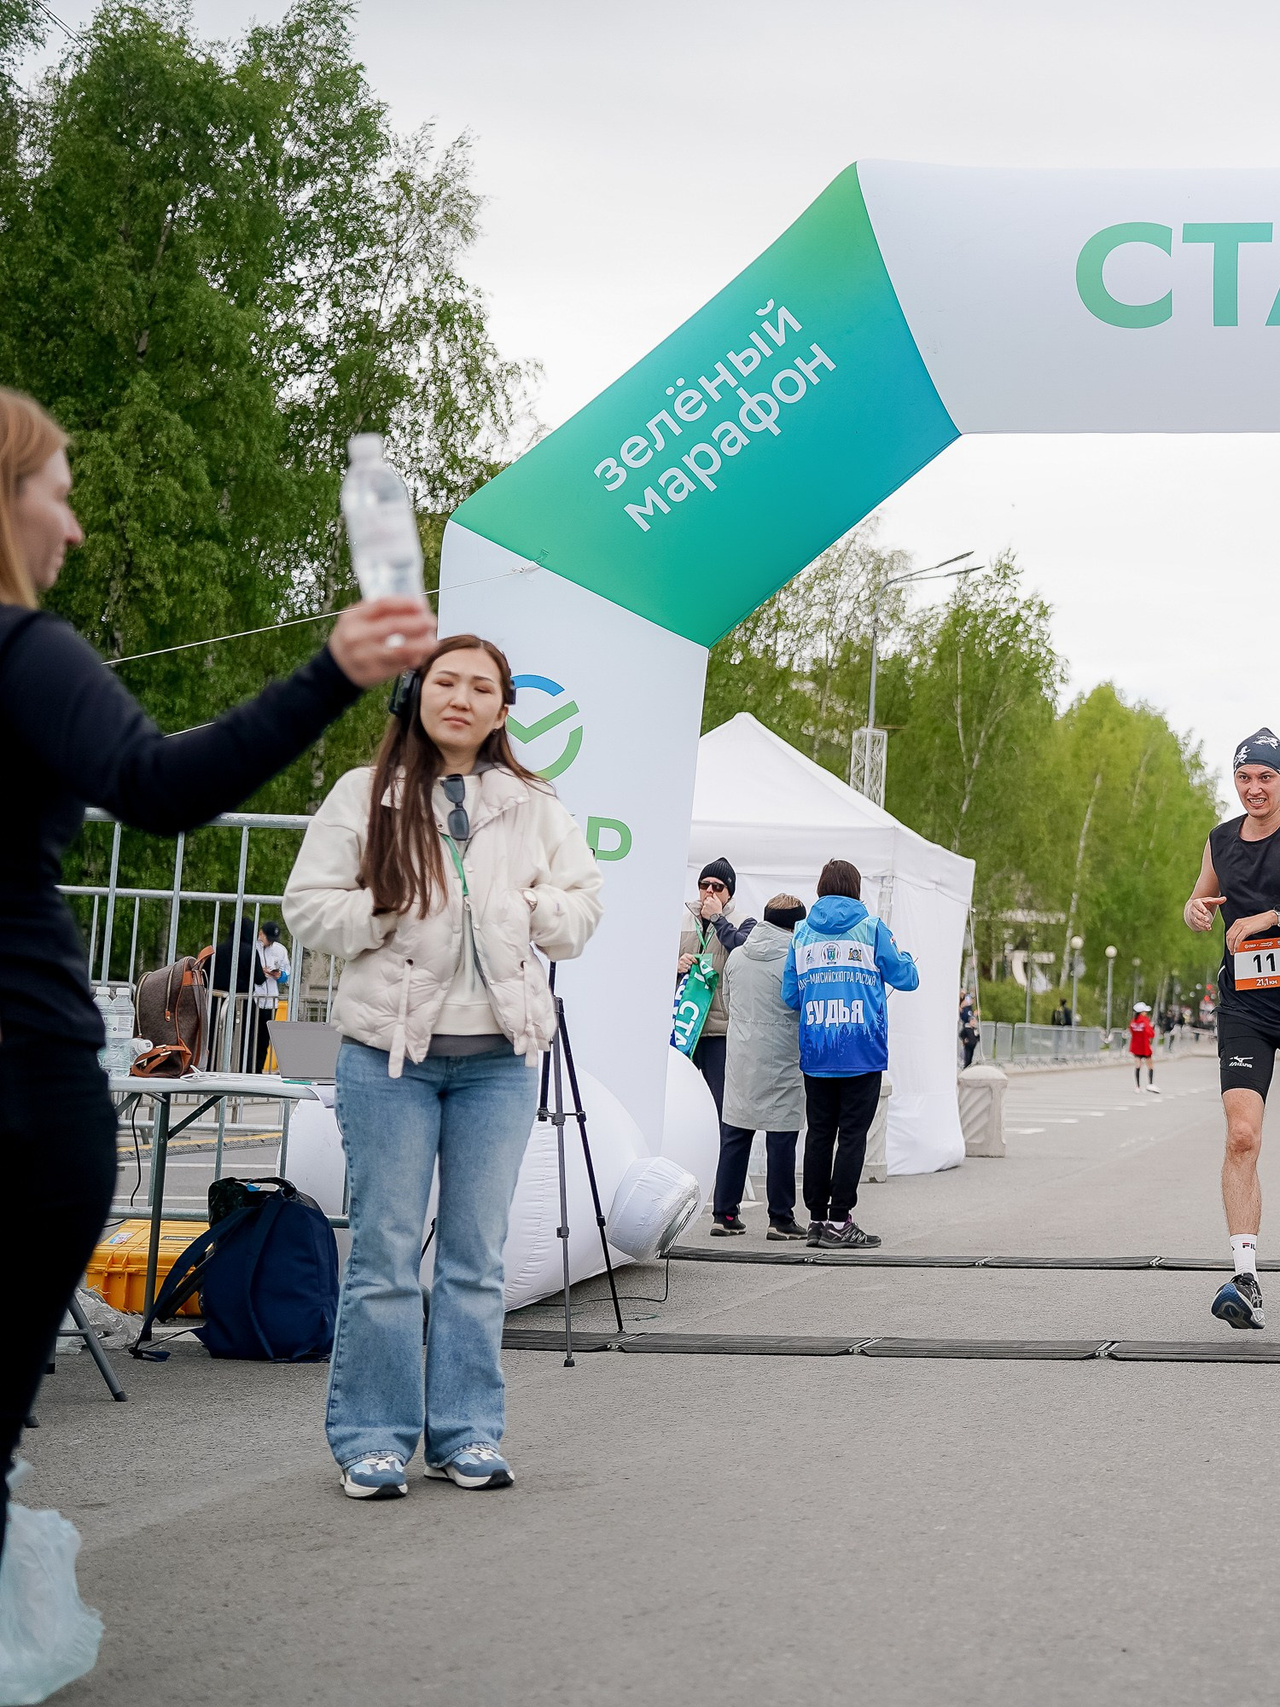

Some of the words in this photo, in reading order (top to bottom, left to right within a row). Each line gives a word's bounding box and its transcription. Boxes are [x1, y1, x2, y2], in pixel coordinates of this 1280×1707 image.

[593, 298, 803, 492] зелёный
[623, 342, 837, 533] марафон
[1253, 953, 1275, 973] 11
[805, 999, 864, 1028] СУДЬЯ
[1242, 1242, 1256, 1251] FIL
